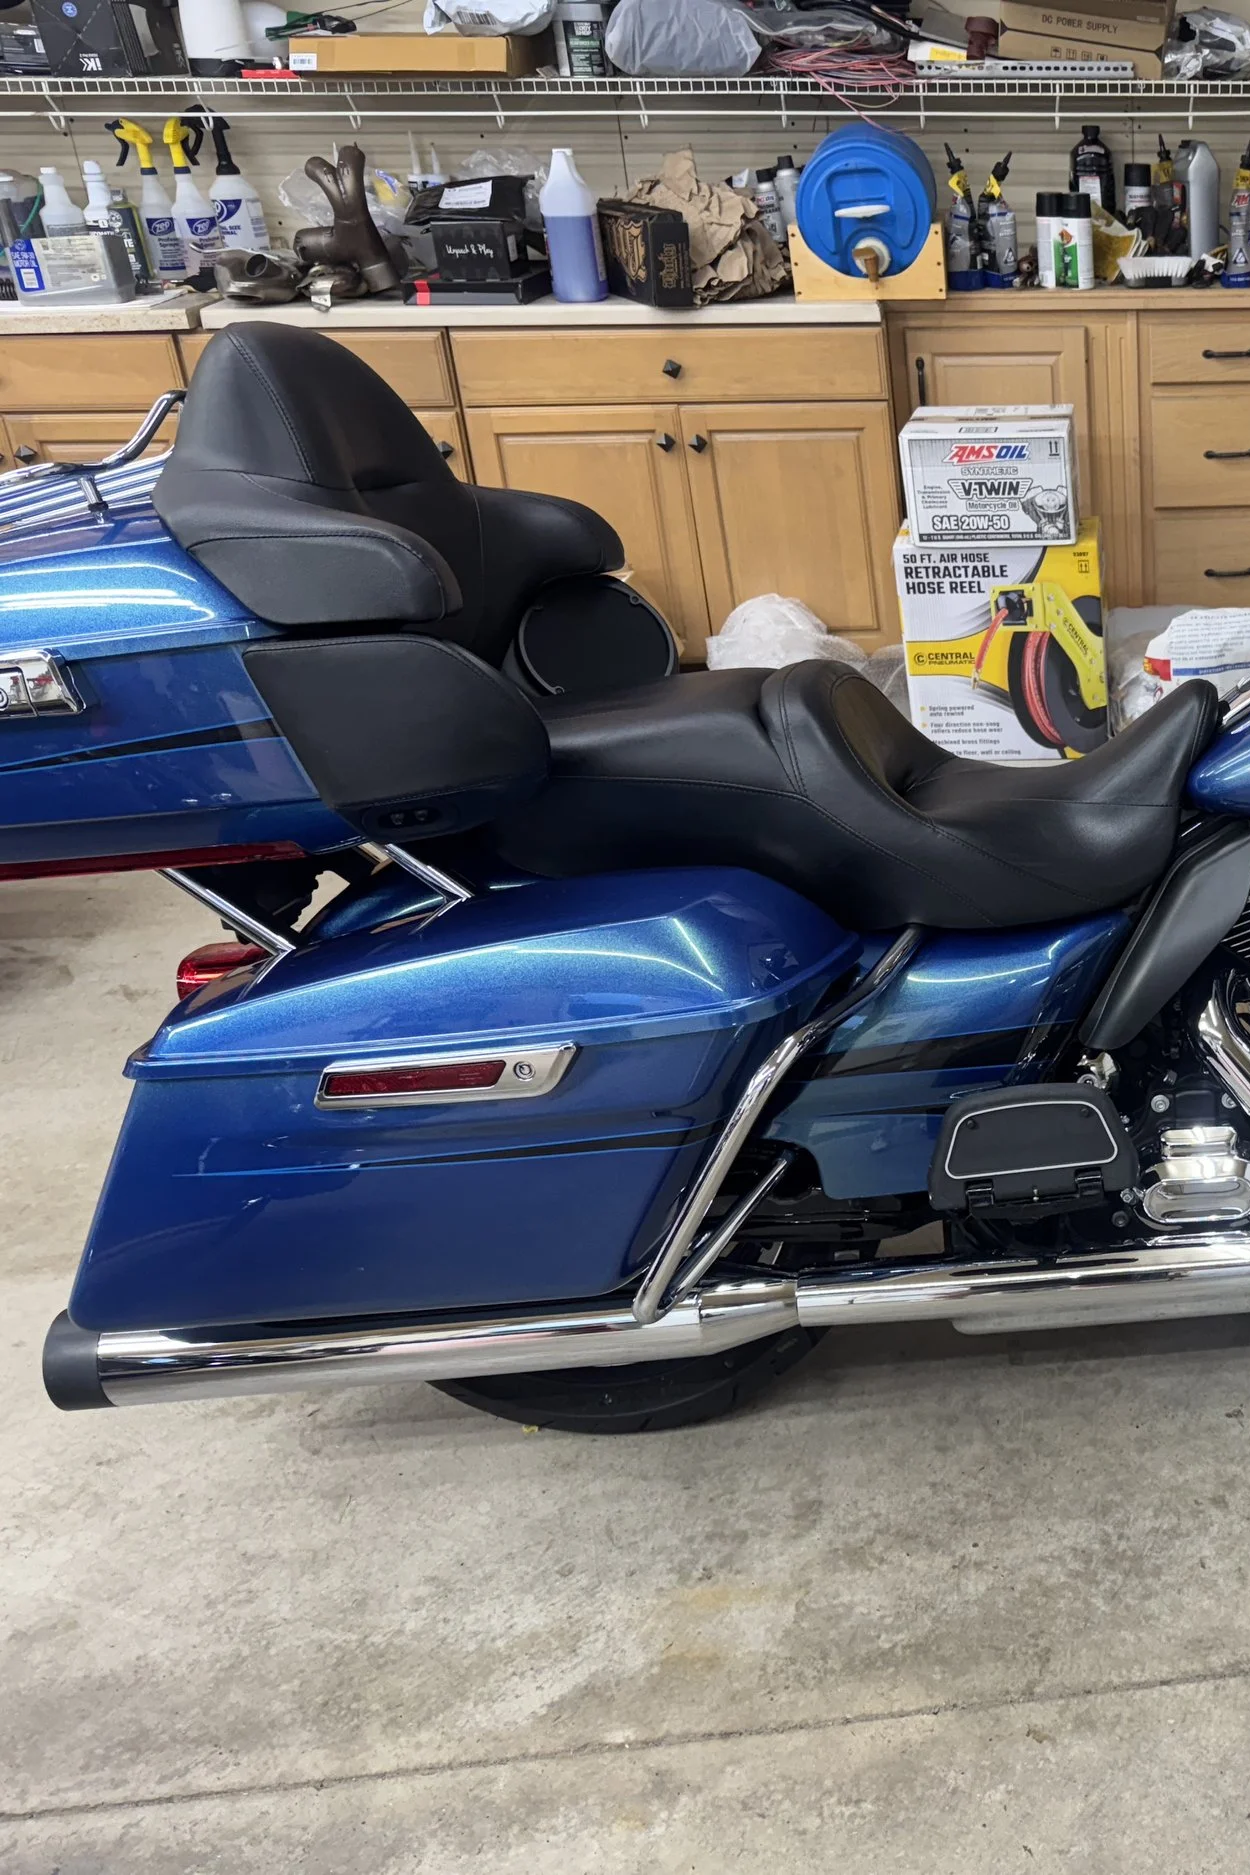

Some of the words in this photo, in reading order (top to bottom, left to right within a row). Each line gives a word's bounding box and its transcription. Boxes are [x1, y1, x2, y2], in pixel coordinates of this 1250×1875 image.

[1042, 14, 1053, 24] DC
[1056, 16, 1082, 28] POWER
[1086, 18, 1118, 34] SUPPLY
[470, 243, 477, 254] &
[944, 443, 1031, 464] AMSOIL
[961, 466, 1018, 476] SYNTHETIC
[961, 480, 1020, 497] V-TWIN
[968, 502, 1007, 511] Motorcycle
[1008, 501, 1017, 510] Oil
[932, 514, 959, 531] SAE
[960, 514, 1010, 531] 20W-50
[903, 554, 917, 564] 50
[920, 554, 936, 564] FT.
[939, 553, 957, 563] AIR
[961, 553, 990, 563] HOSE
[904, 564, 1009, 579] RETRACTABLE
[906, 582, 945, 595] HOSE
[949, 581, 986, 594] REEL
[928, 652, 975, 661] CENTRAL
